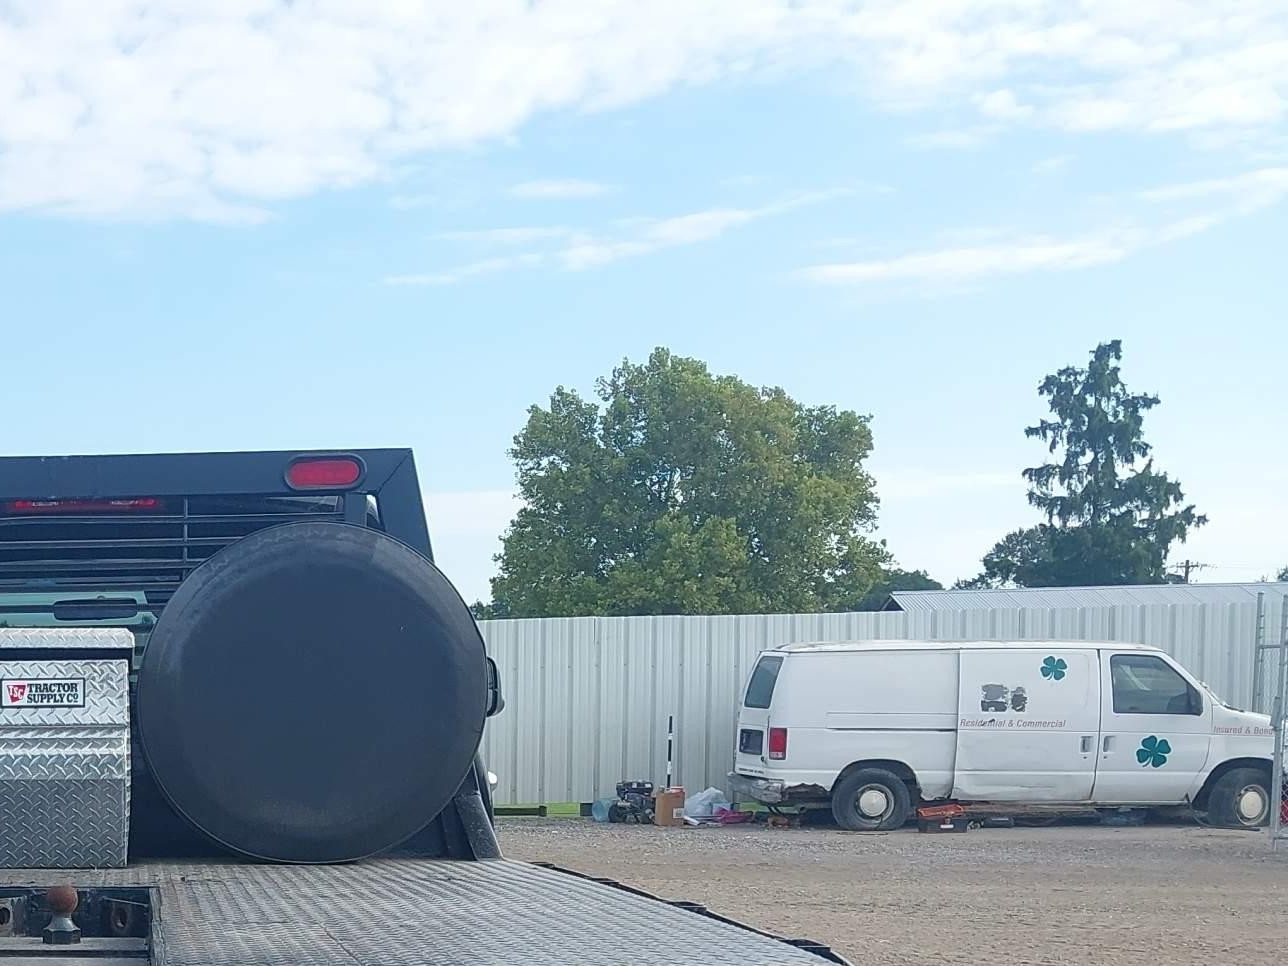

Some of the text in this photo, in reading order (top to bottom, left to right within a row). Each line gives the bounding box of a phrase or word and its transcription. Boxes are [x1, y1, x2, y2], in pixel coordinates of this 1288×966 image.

[8, 685, 24, 699] TSC
[27, 682, 79, 693] TRACTOR
[26, 693, 66, 704] SUPPLY
[960, 718, 1066, 729] Residential & Commercial
[1213, 726, 1243, 735] Insured
[1244, 727, 1251, 735] &
